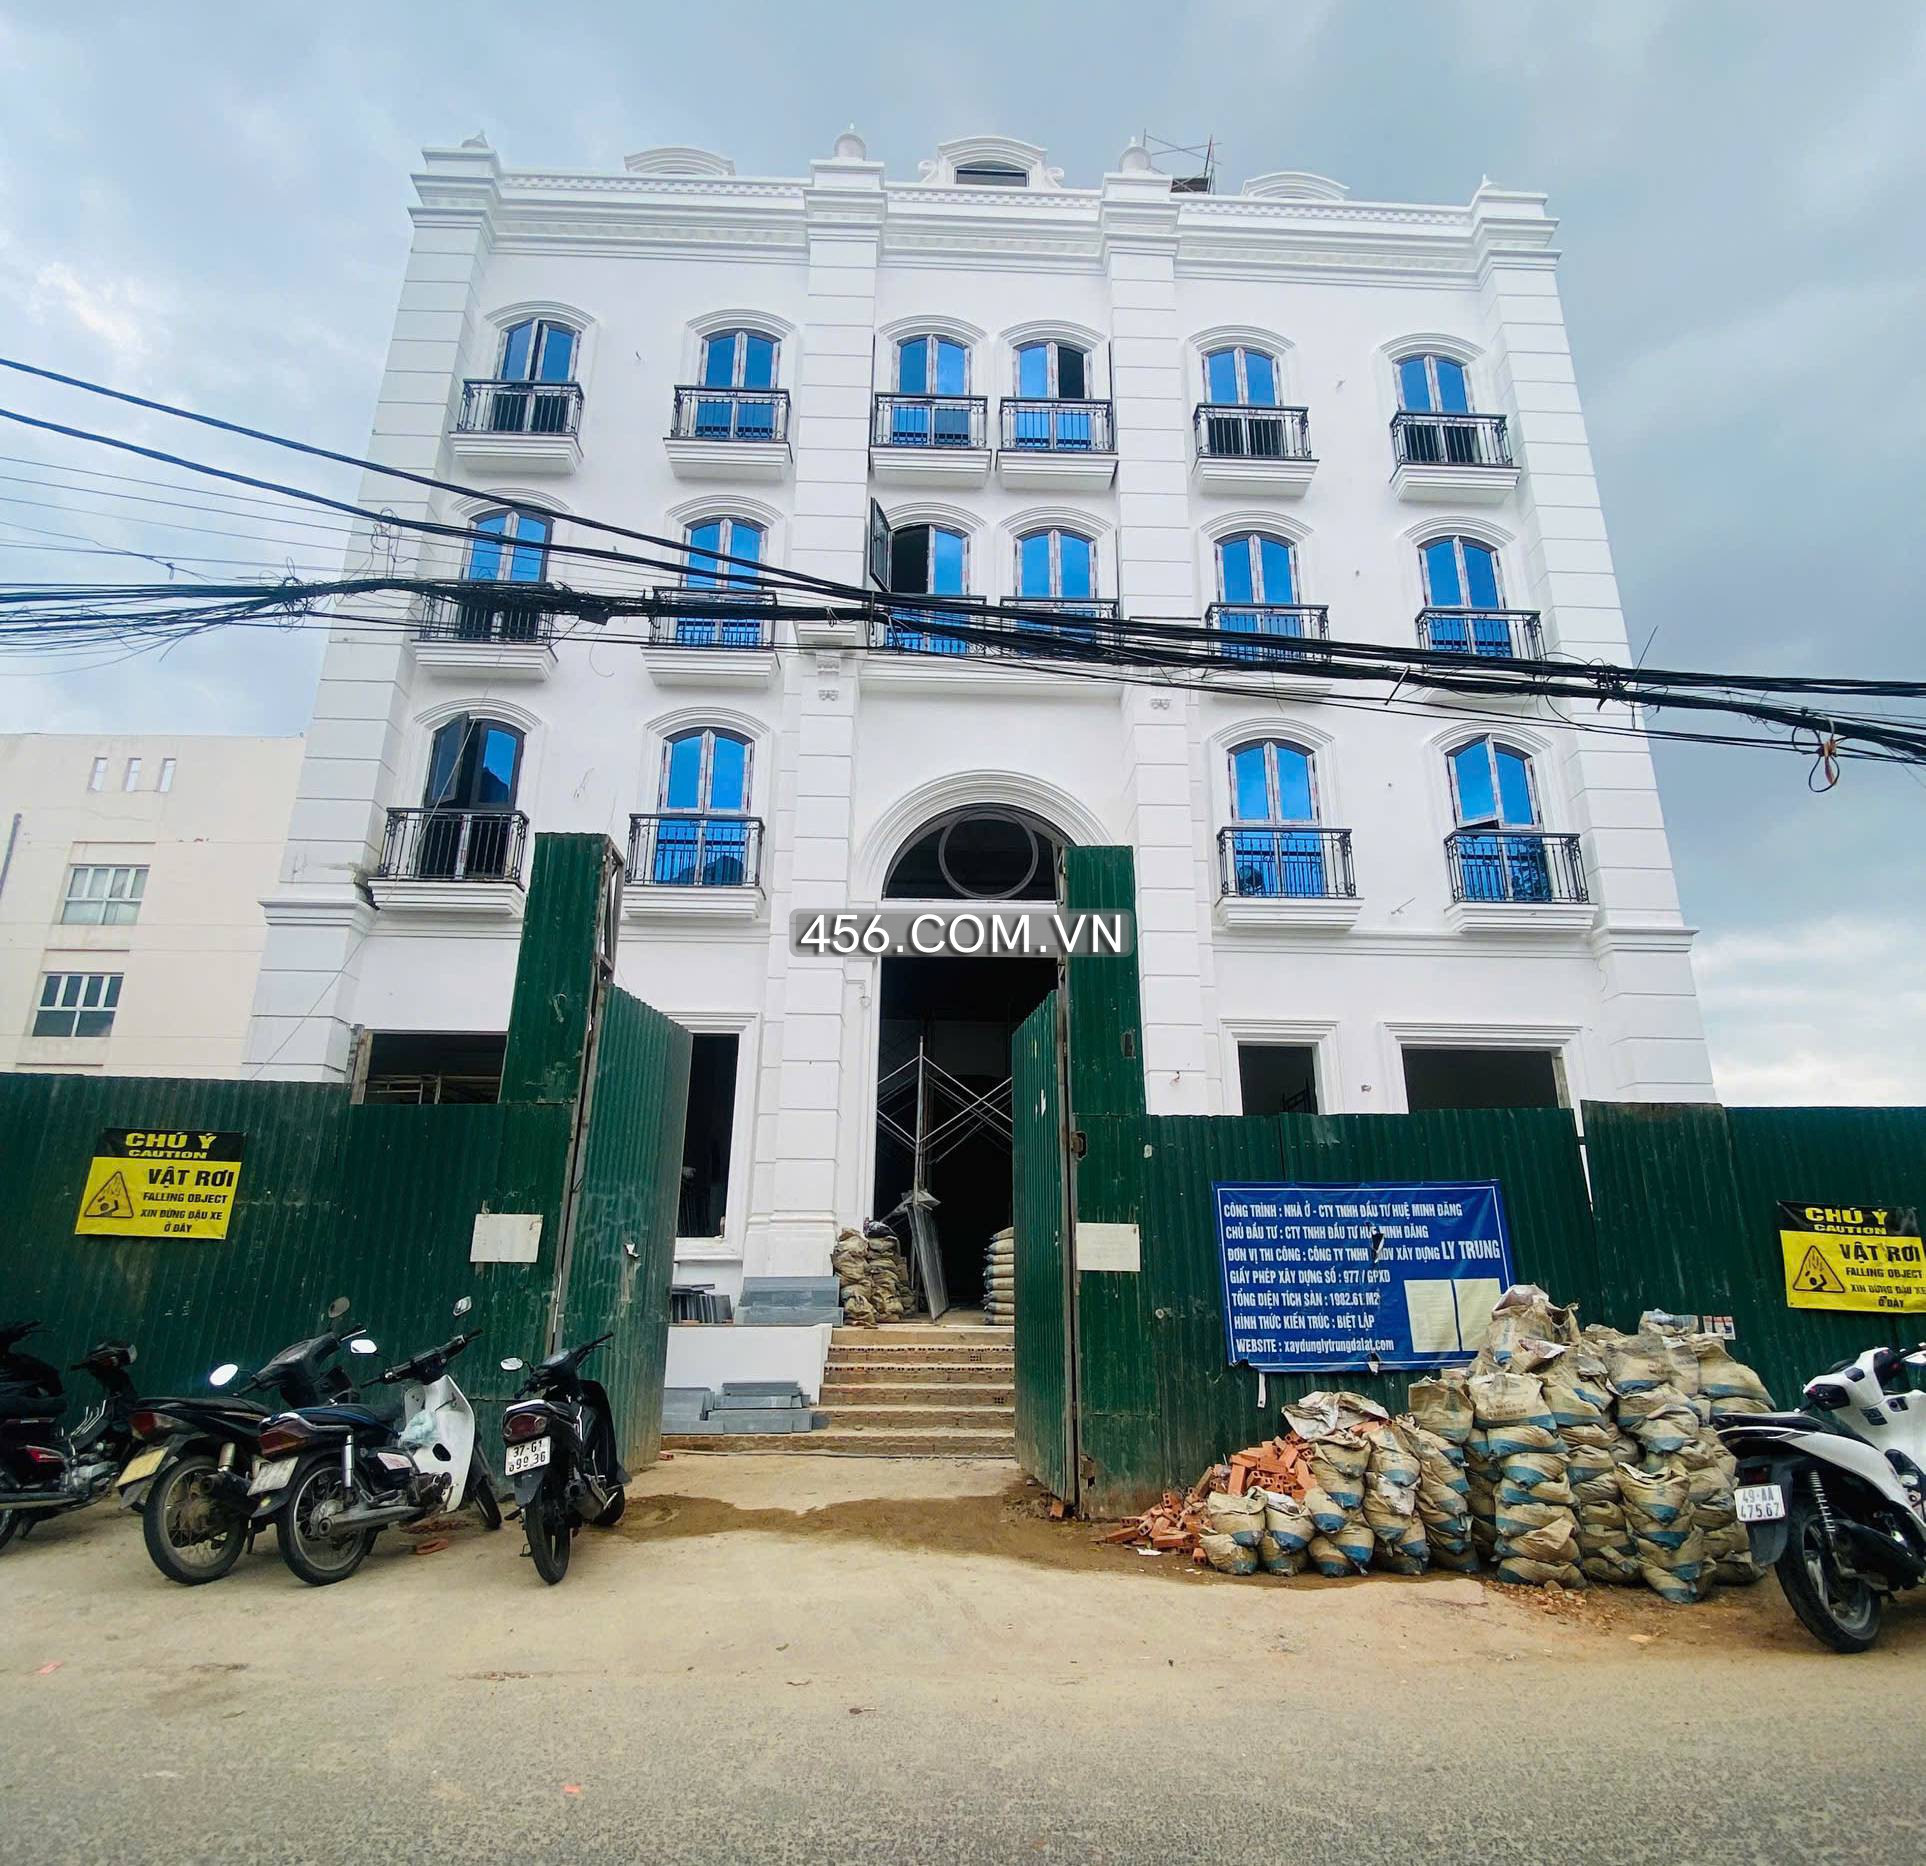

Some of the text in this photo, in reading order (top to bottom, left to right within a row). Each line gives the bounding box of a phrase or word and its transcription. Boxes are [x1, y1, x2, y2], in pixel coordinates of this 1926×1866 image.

[125, 1132, 217, 1149] CHÚ Ý
[128, 1149, 208, 1159] CAUTION
[148, 1165, 235, 1188] VẬT RƠI
[143, 1191, 228, 1204] FALLING OBJECT
[140, 1209, 157, 1218] XIN
[209, 1211, 222, 1220] XE
[1224, 1201, 1249, 1217] CÔNG
[1249, 1201, 1277, 1217] TRÌNH
[1284, 1201, 1303, 1217] NHÀ
[1304, 1200, 1311, 1217] Ở
[1318, 1204, 1334, 1217] CTY
[1335, 1204, 1359, 1217] TNHH
[1379, 1203, 1391, 1217] TƯ
[1392, 1201, 1410, 1220] HUỆ
[1412, 1203, 1436, 1217] MINH
[1804, 1207, 1888, 1225] CHÚ Ý
[1225, 1221, 1244, 1239] CHỦ
[1266, 1225, 1278, 1239] TƯ
[1285, 1226, 1300, 1239] CTY
[1302, 1226, 1326, 1239] TNHH
[1346, 1225, 1358, 1239] TƯ
[1813, 1224, 1887, 1235] CAUTION
[1227, 1246, 1247, 1262] ĐƠN
[1248, 1248, 1258, 1264] VỊ
[1260, 1248, 1274, 1262] THI
[1275, 1245, 1301, 1262] CÔNG
[1307, 1245, 1332, 1262] CÔNG
[1332, 1248, 1343, 1261] TY
[1345, 1248, 1369, 1261] TNHH
[1396, 1245, 1413, 1261] XÂY
[1415, 1246, 1440, 1263] DỰNG
[1458, 1239, 1501, 1260] TRUNG
[1839, 1241, 1921, 1264] VẬT RƠI
[1230, 1266, 1250, 1284] GIẤY
[1252, 1268, 1276, 1284] PHÉP
[1278, 1268, 1297, 1284] XÂY
[1298, 1269, 1323, 1286] DỰNG
[1324, 1265, 1336, 1283] SỐ
[1343, 1270, 1359, 1283] 977
[1845, 1267, 1922, 1279] FALLING OBJECT
[1232, 1288, 1256, 1307] TỔNG
[1258, 1290, 1279, 1309] DIỆN
[1281, 1290, 1301, 1307] TÍCH
[1304, 1290, 1323, 1306] SÀN
[1234, 1313, 1257, 1329] HÌNH
[1258, 1313, 1282, 1329] THỨC
[1283, 1311, 1306, 1329] KIẾN
[1307, 1313, 1330, 1329] TRÚC
[1337, 1312, 1356, 1331] BIỆT
[1357, 1312, 1375, 1331] LẬP
[1236, 1338, 1277, 1352] WEBSITE
[1284, 1338, 1395, 1354] xaydunglytrungdalat.com
